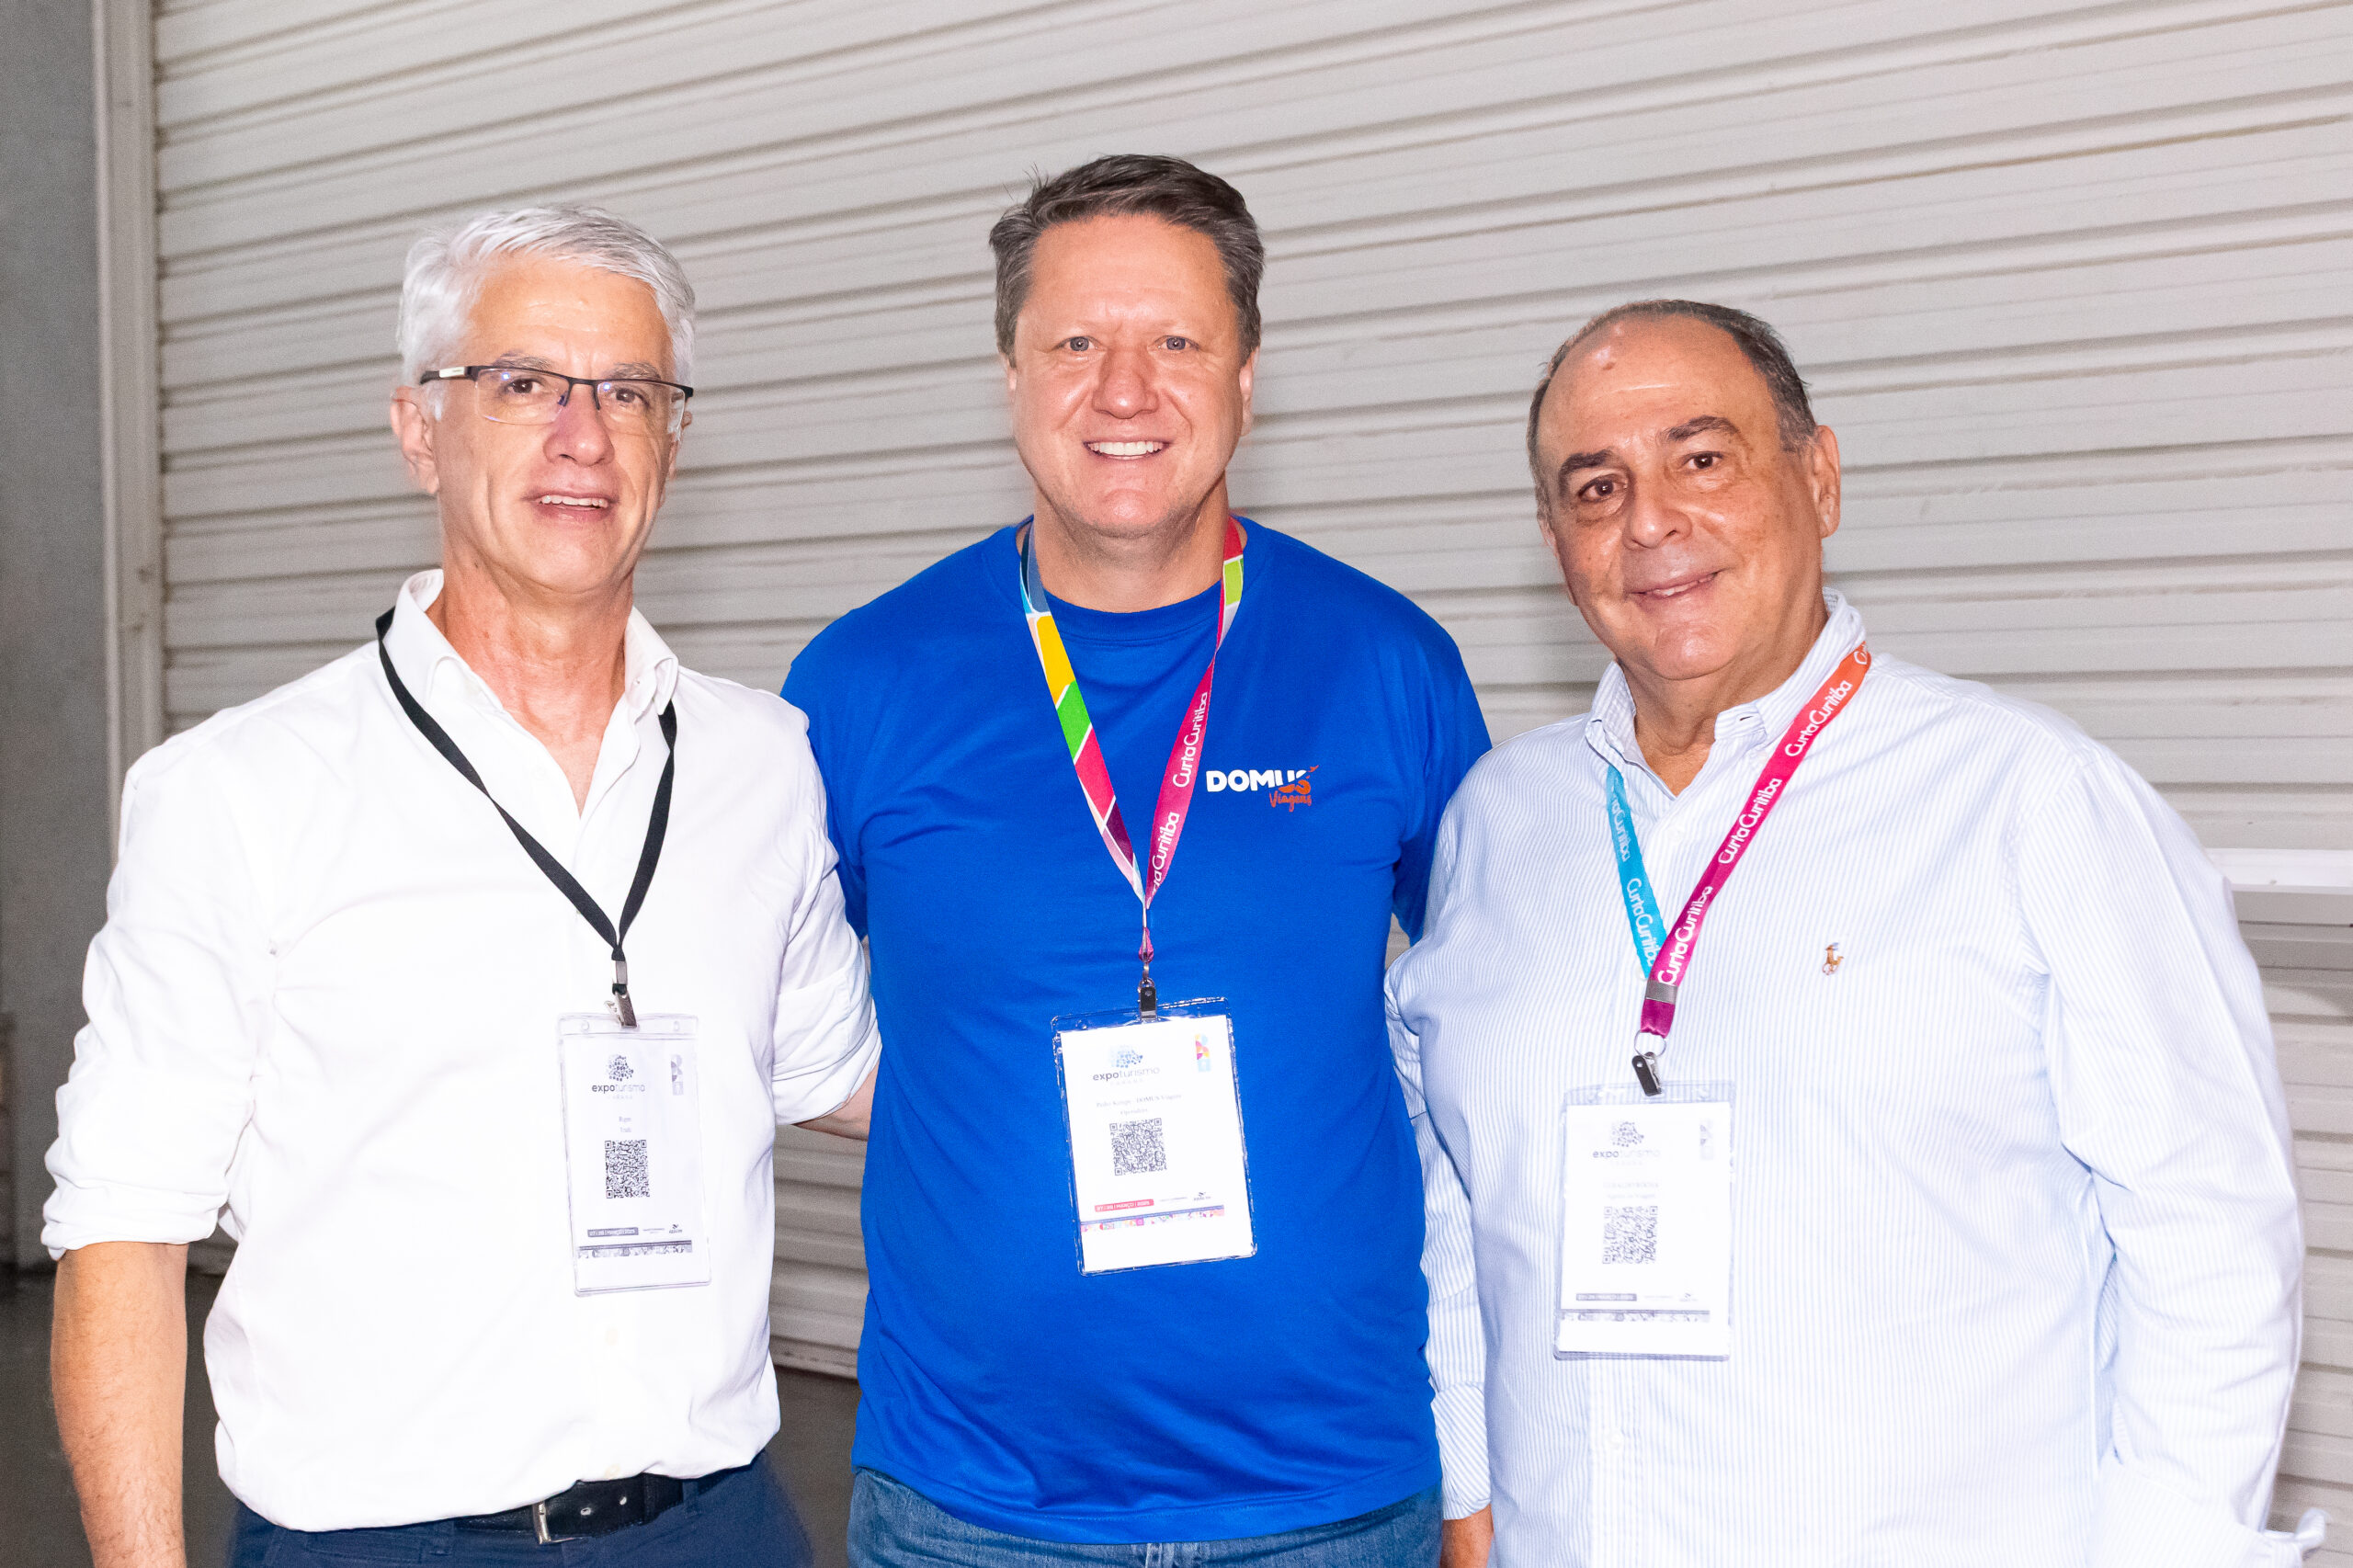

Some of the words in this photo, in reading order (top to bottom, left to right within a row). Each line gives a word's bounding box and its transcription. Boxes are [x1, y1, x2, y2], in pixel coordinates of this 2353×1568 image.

[1173, 692, 1208, 788] CurtaCuritiba
[1785, 679, 1853, 756] CurtaCuritiba
[1206, 769, 1312, 794] DOMUS
[1268, 790, 1313, 812] Viagens
[1718, 778, 1782, 864] CurtaCuritiba
[1657, 886, 1713, 986] CurtaCuritiba
[1093, 1067, 1160, 1082] expoturismo
